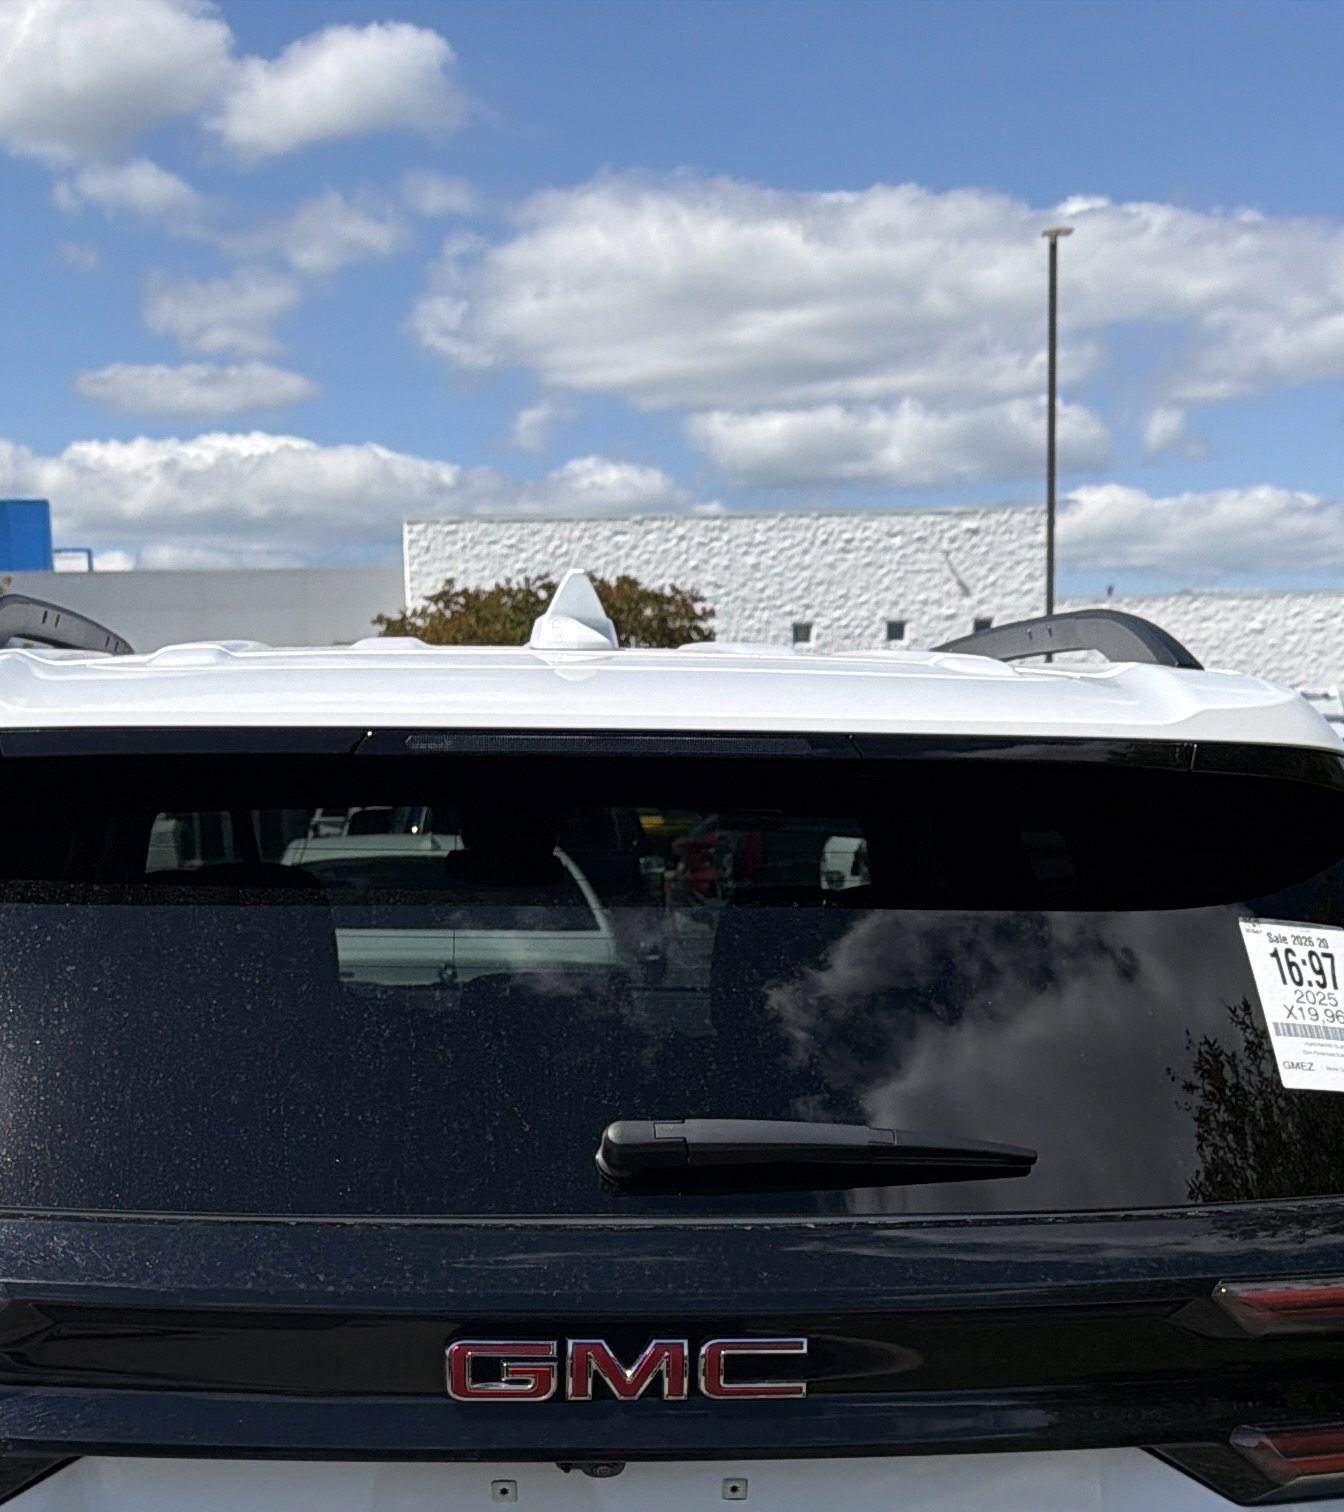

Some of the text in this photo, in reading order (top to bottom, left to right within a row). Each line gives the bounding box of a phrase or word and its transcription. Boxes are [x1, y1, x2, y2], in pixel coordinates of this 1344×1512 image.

[1266, 932, 1288, 944] Sale
[1269, 947, 1338, 990] 16:97
[1294, 989, 1338, 1007] 2025
[1283, 1060, 1315, 1072] GMEZ
[446, 1338, 808, 1401] GMC
